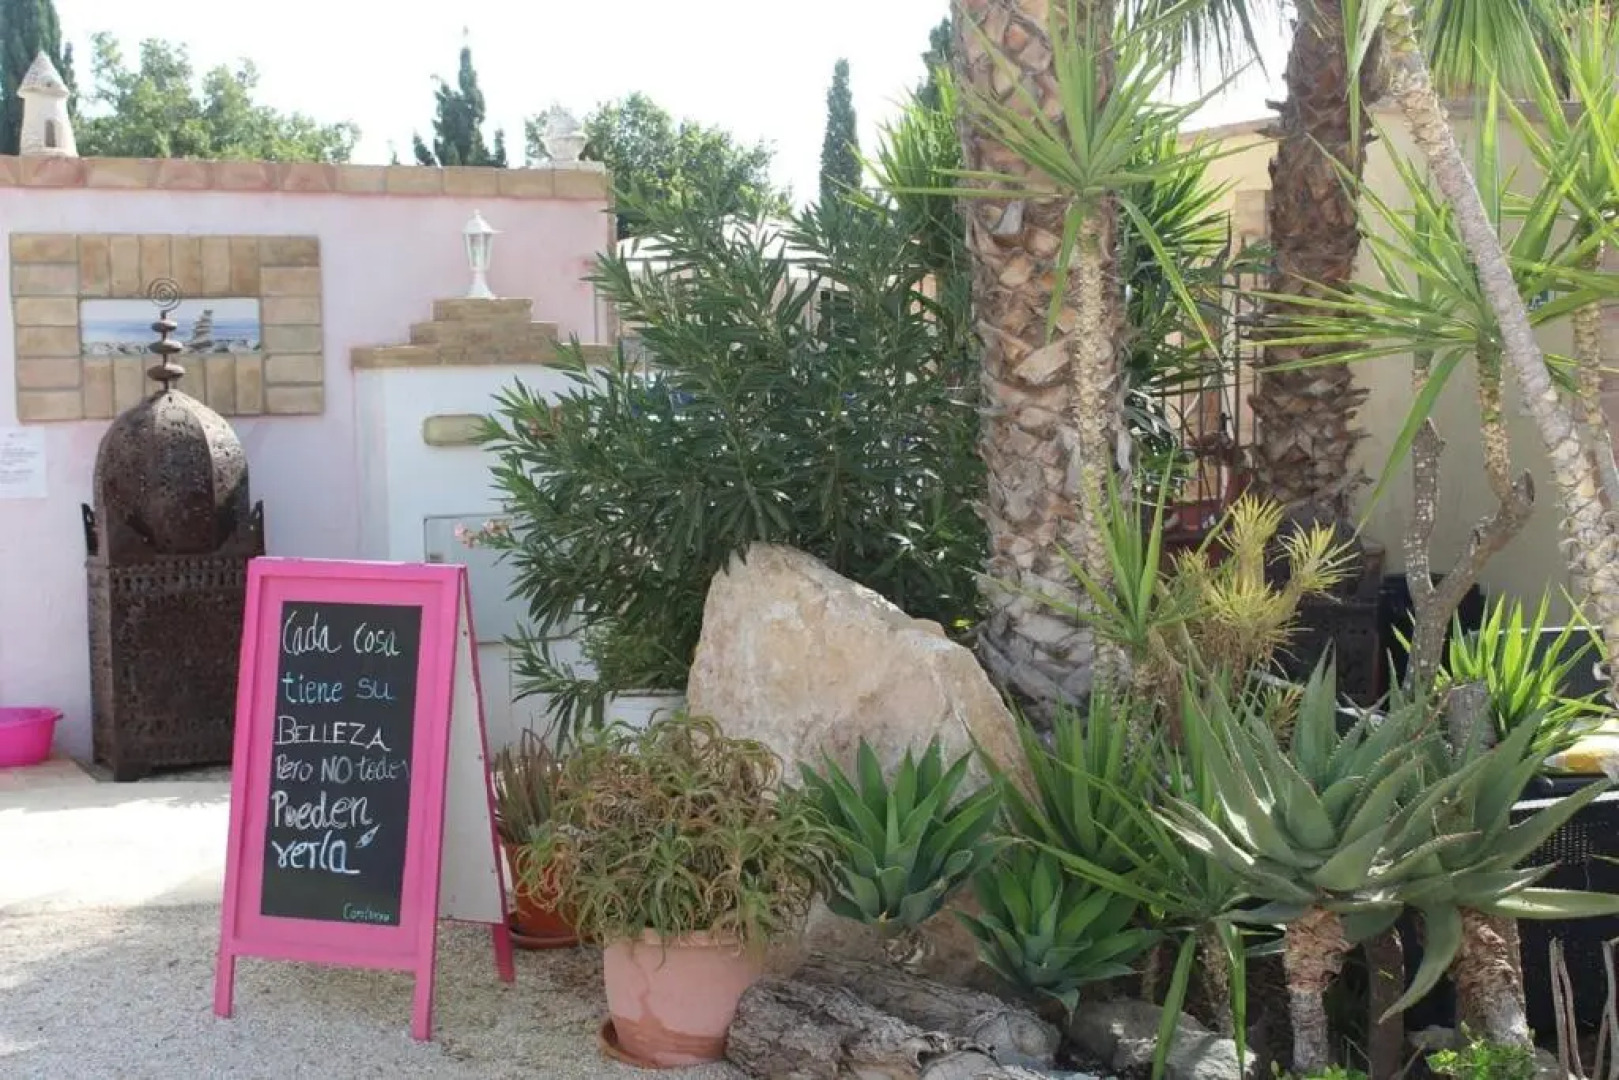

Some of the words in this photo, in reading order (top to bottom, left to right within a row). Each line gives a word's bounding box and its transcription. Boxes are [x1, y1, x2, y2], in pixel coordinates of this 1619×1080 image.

[283, 611, 342, 656] Cada
[282, 671, 342, 704] tiene
[275, 753, 313, 782] Pero
[321, 756, 353, 784] NO
[271, 790, 373, 830] Pueden
[271, 830, 361, 874] verla
